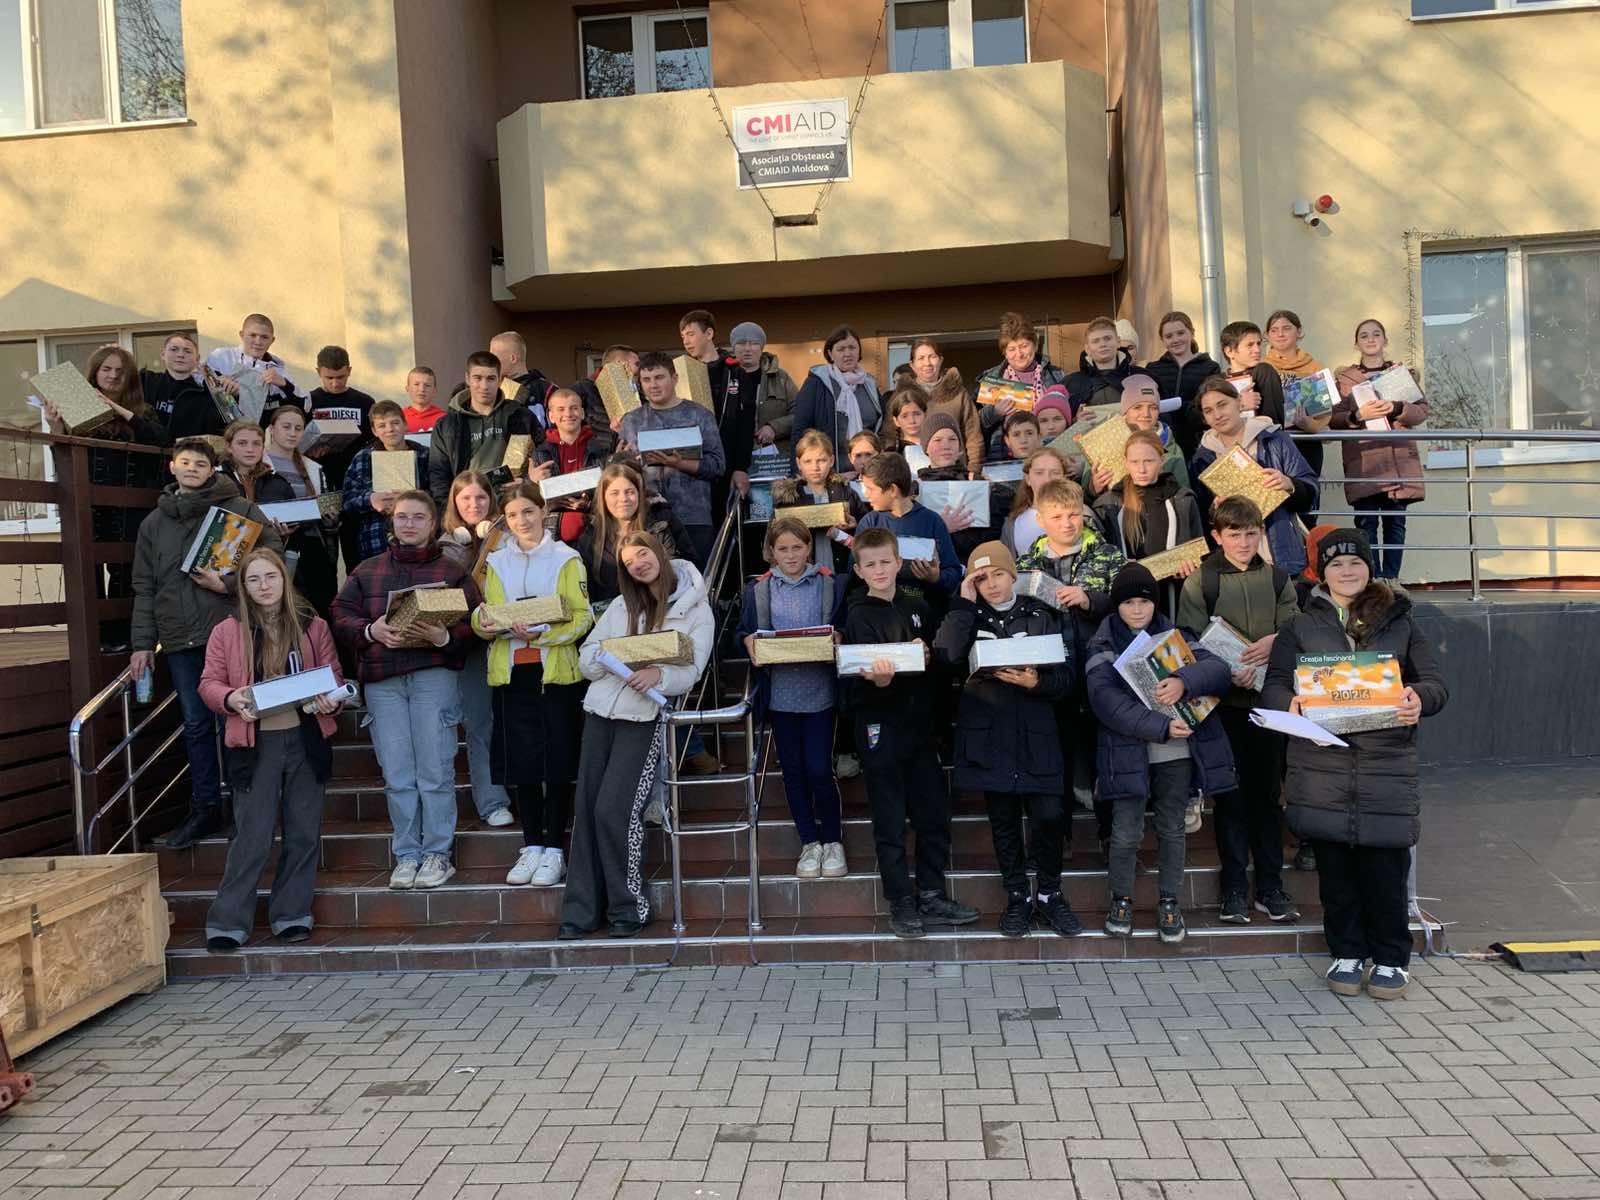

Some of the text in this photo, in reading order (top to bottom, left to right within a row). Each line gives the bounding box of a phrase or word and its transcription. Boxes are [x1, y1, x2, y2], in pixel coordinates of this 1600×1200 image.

[747, 112, 836, 136] CMIAID
[758, 164, 829, 176] CMIAID Moldova
